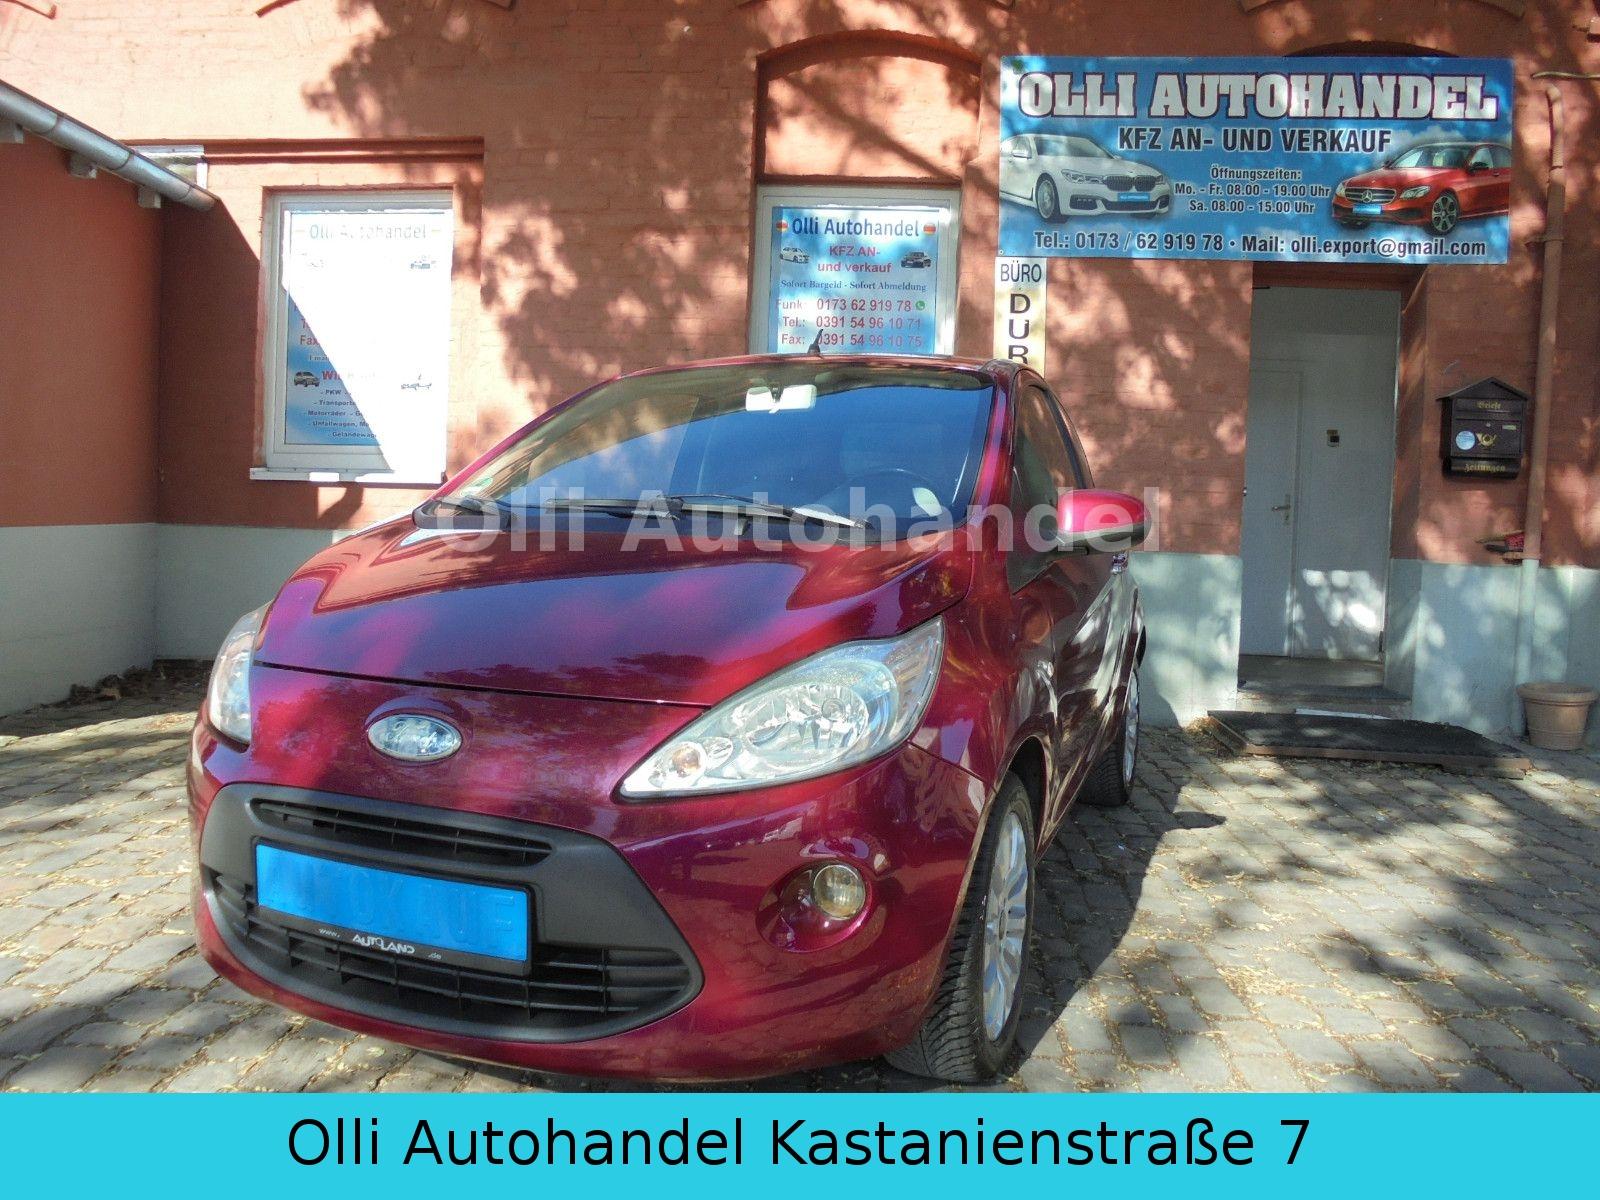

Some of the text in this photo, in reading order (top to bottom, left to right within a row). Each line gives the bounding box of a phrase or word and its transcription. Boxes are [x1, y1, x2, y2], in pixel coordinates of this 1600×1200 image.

[1019, 72, 1498, 121] OLLI AUTOHANDEL
[1119, 127, 1391, 153] KFZ AN- UND VERKAUF
[1211, 164, 1301, 181] Öffnungszeiten:
[1175, 183, 1196, 195] Mo.
[1209, 183, 1223, 195] Fr.
[1226, 184, 1260, 196] 08.00
[1273, 184, 1306, 197] 19.00
[1310, 185, 1330, 197] Uhr
[1189, 200, 1207, 212] Sa.
[1211, 200, 1244, 212] 08.00
[1258, 201, 1290, 213] 15.00
[1294, 201, 1315, 213] Uhr
[792, 218, 919, 237] Olli Autohandel
[829, 246, 855, 256] KFZ
[1034, 231, 1069, 248] Tel.:
[1075, 232, 1119, 249] 0173
[1136, 233, 1157, 250] 62
[1163, 234, 1196, 251] 919
[1202, 234, 1223, 252] 78
[1241, 235, 1284, 253] Mail:
[1291, 236, 1486, 258] olli.export@gmail.com
[817, 262, 841, 272] und
[1001, 260, 1042, 283] BÜRO
[781, 280, 808, 288] Sofort
[809, 280, 842, 290] Bargeld
[850, 281, 876, 289] Sofort
[877, 281, 926, 292] Abmeldung
[817, 298, 847, 311] 0173
[851, 299, 866, 311] 62
[869, 299, 892, 311] 919
[896, 300, 911, 311] 78
[816, 316, 845, 327] 0391
[850, 317, 865, 328] 54
[869, 317, 884, 328] 96
[889, 318, 903, 329] 10
[907, 318, 921, 329] 71
[781, 333, 805, 344] Fax:
[850, 334, 865, 345] 54
[352, 934, 415, 954] AUTOLAND
